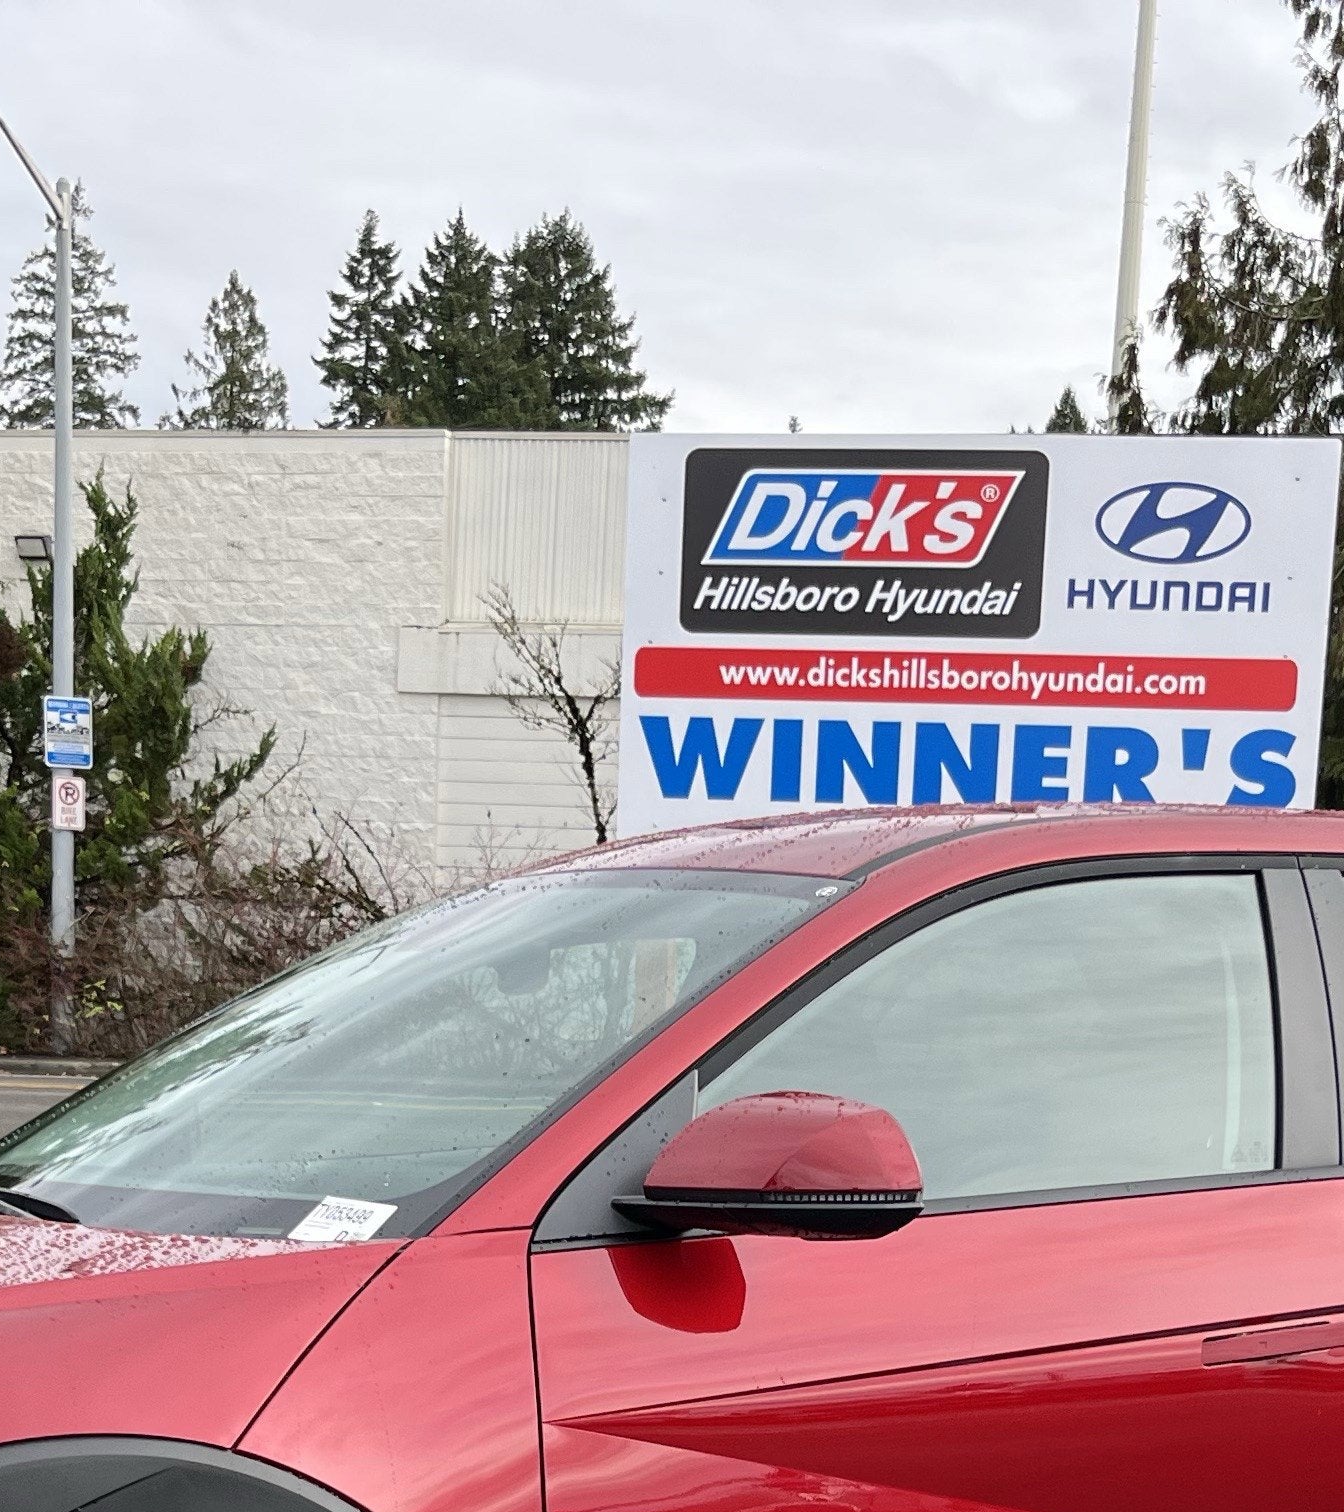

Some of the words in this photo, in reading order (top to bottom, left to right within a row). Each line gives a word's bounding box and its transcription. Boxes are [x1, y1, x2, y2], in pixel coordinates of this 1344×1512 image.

[693, 576, 858, 613] Hillsboro
[865, 579, 1023, 622] Hyundai
[1068, 578, 1271, 613] HYUNDAI
[719, 658, 1206, 701] www.dickshillsborohyundai.com
[639, 715, 1297, 808] WINNER'S
